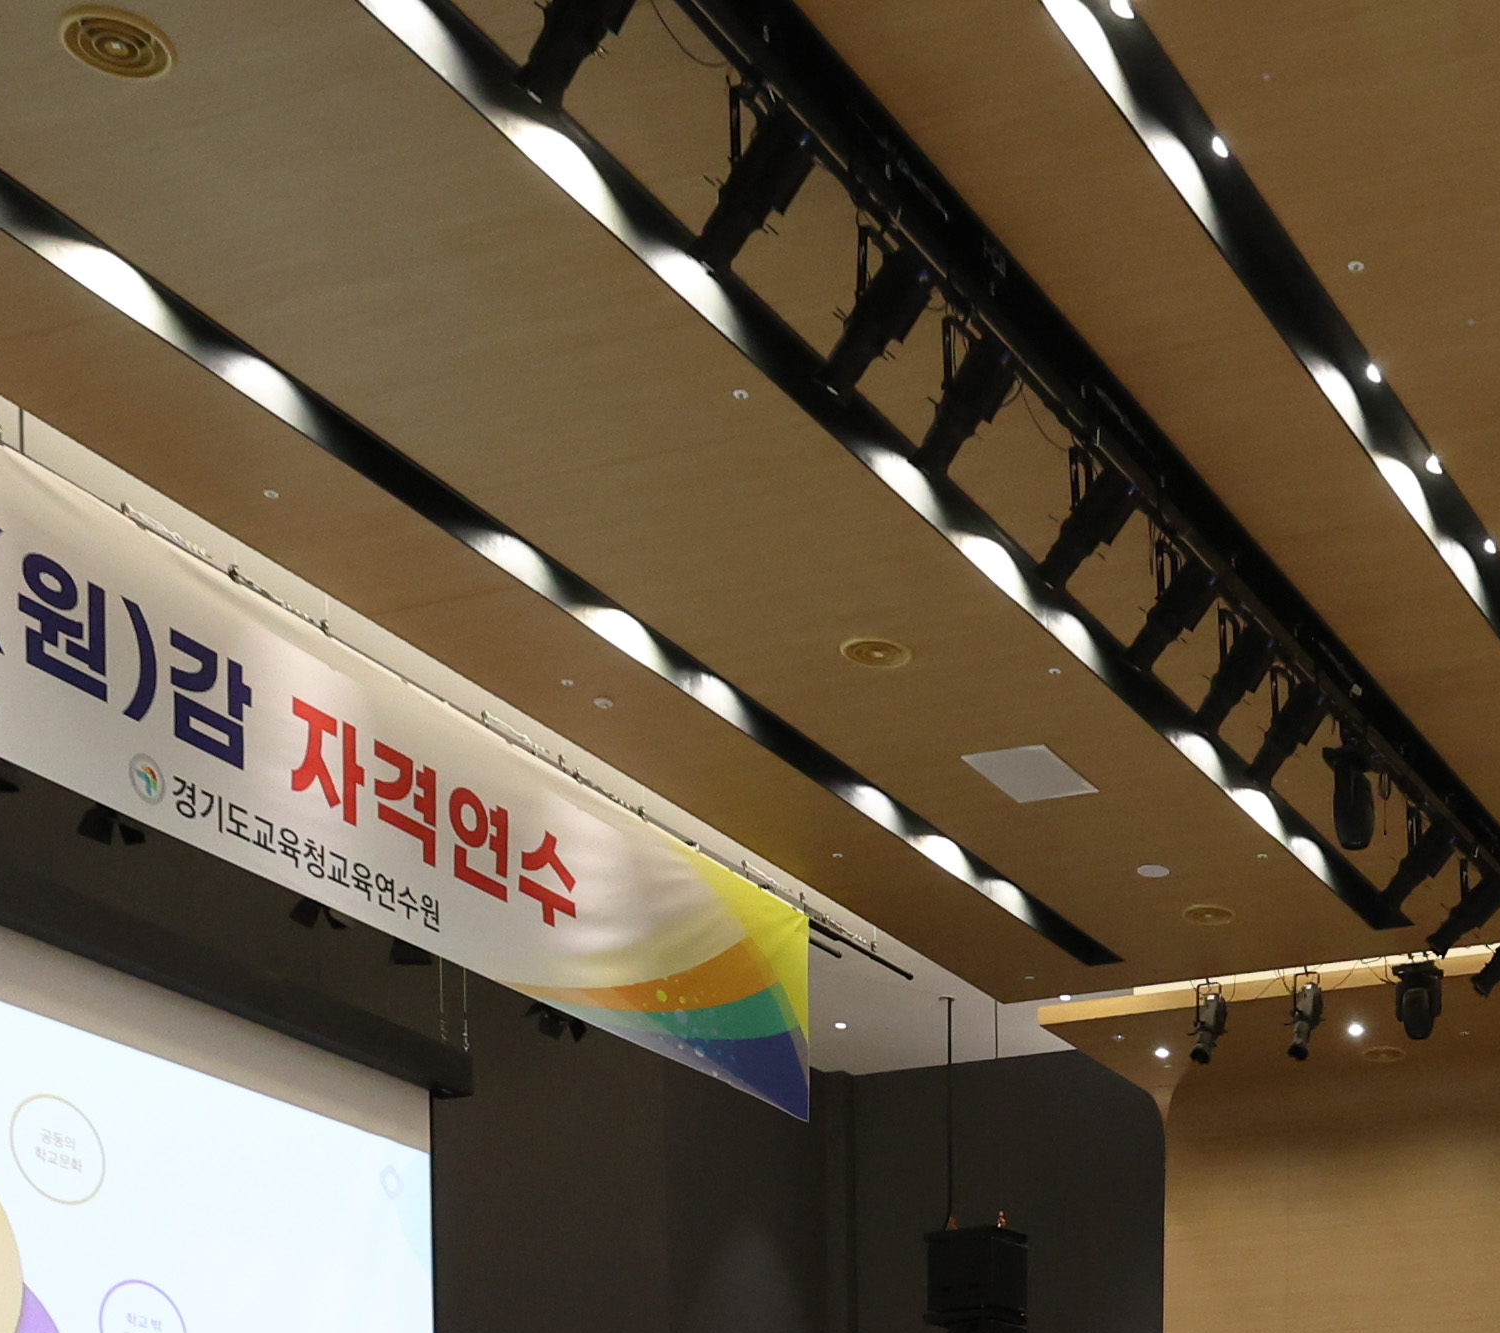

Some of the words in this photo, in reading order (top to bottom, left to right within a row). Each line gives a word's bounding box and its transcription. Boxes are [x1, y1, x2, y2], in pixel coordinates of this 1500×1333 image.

[172, 775, 441, 934] 경기도교육청교육연수원
[290, 695, 577, 929] 자격연수
[125, 1311, 149, 1330] 학교
